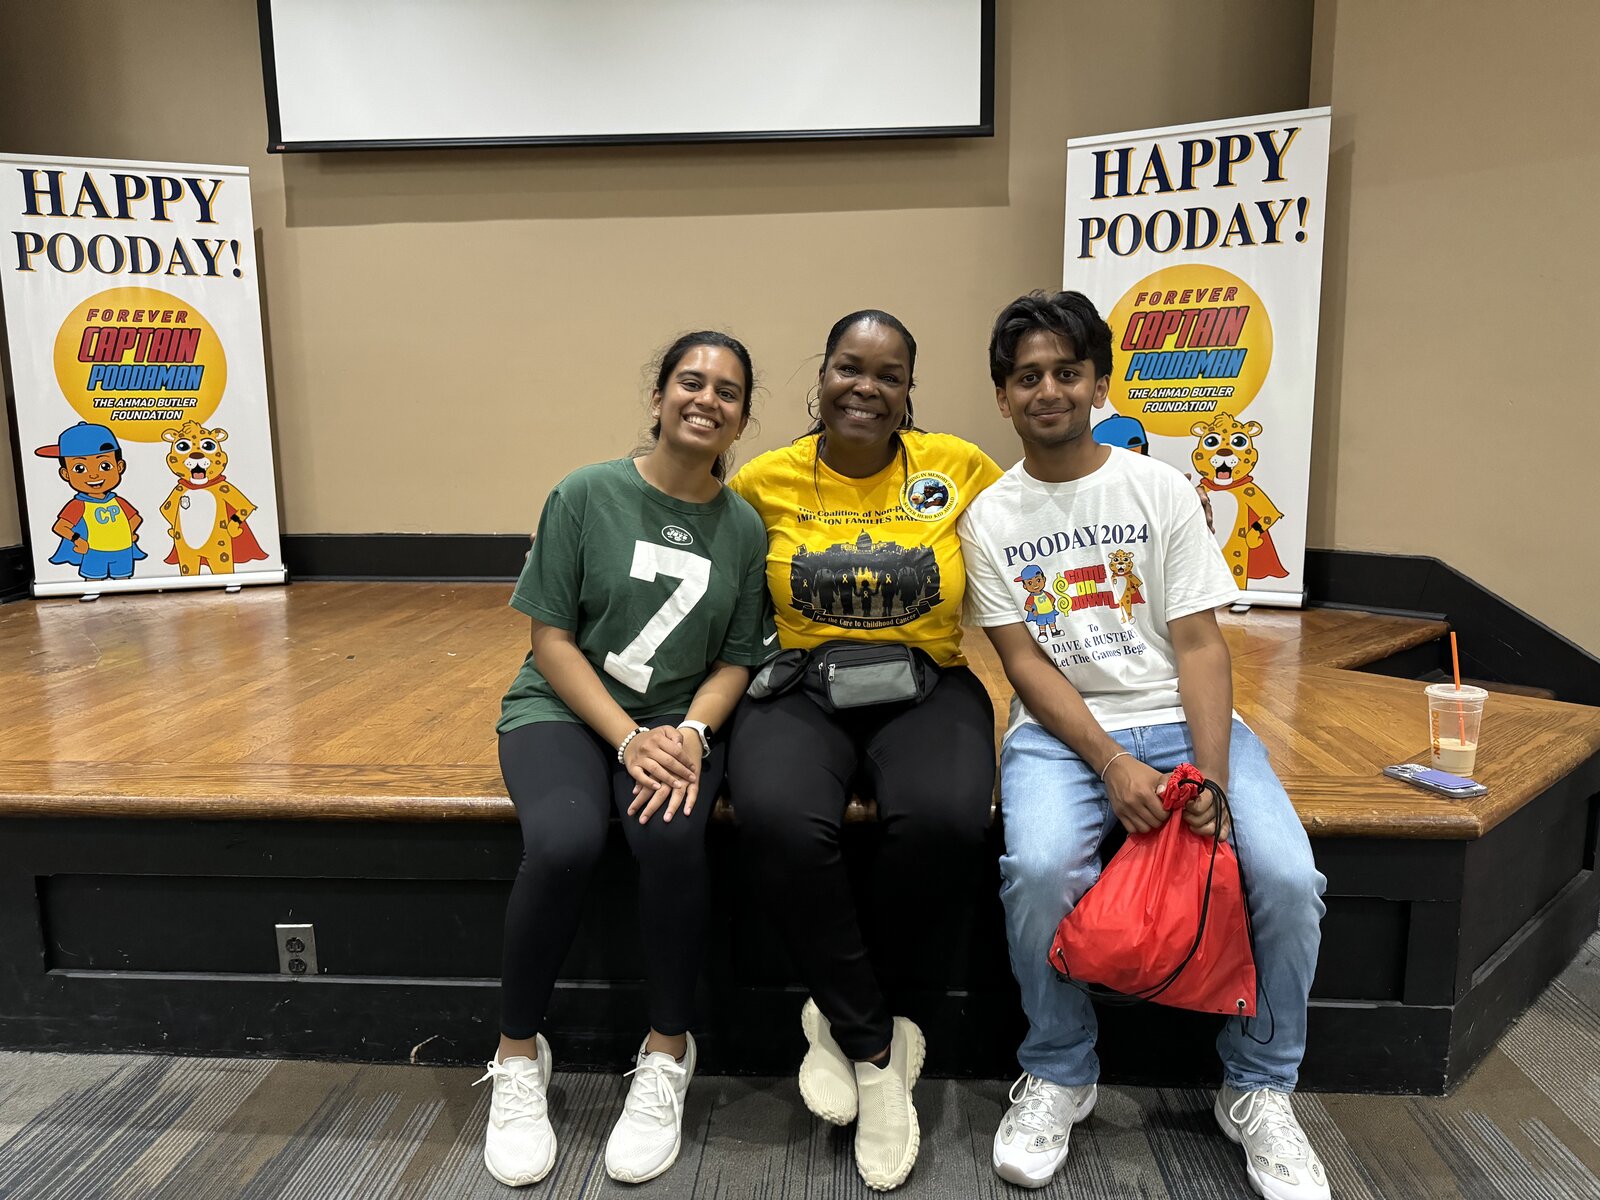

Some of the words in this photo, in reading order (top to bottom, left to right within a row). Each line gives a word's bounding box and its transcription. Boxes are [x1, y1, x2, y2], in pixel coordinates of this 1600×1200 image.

[1090, 127, 1301, 200] HAPPY
[17, 168, 225, 224] HAPPY
[1077, 196, 1310, 259] POODAY!
[11, 231, 244, 279] POODAY!
[1135, 286, 1238, 307] FOREVER
[86, 308, 189, 323] FOREVER
[1121, 305, 1250, 351] CAPTAIN
[78, 326, 201, 363] CAPTAIN
[1125, 348, 1247, 382] POODAMAN
[87, 364, 205, 391] POODAMAN
[1128, 387, 1150, 400] THE
[1150, 386, 1190, 399] AHMAD
[1191, 385, 1233, 398] BUTLER
[93, 398, 115, 408] THE
[116, 398, 156, 408] AHMAD
[156, 398, 197, 408] BUTLER
[1143, 400, 1216, 413] FOUNDATION
[111, 409, 182, 421] FOUNDATION
[95, 505, 120, 524] CP
[845, 515, 892, 525] FAMILIES
[875, 505, 905, 517] Non-P
[603, 539, 712, 694] 7
[862, 619, 894, 628] Childhood
[895, 613, 917, 625] Cancer
[1088, 624, 1099, 633] To
[1052, 640, 1082, 654] DAVE
[1084, 637, 1093, 649] &
[1053, 657, 1070, 668] Let
[1070, 653, 1091, 665] The
[1091, 648, 1122, 662] Games
